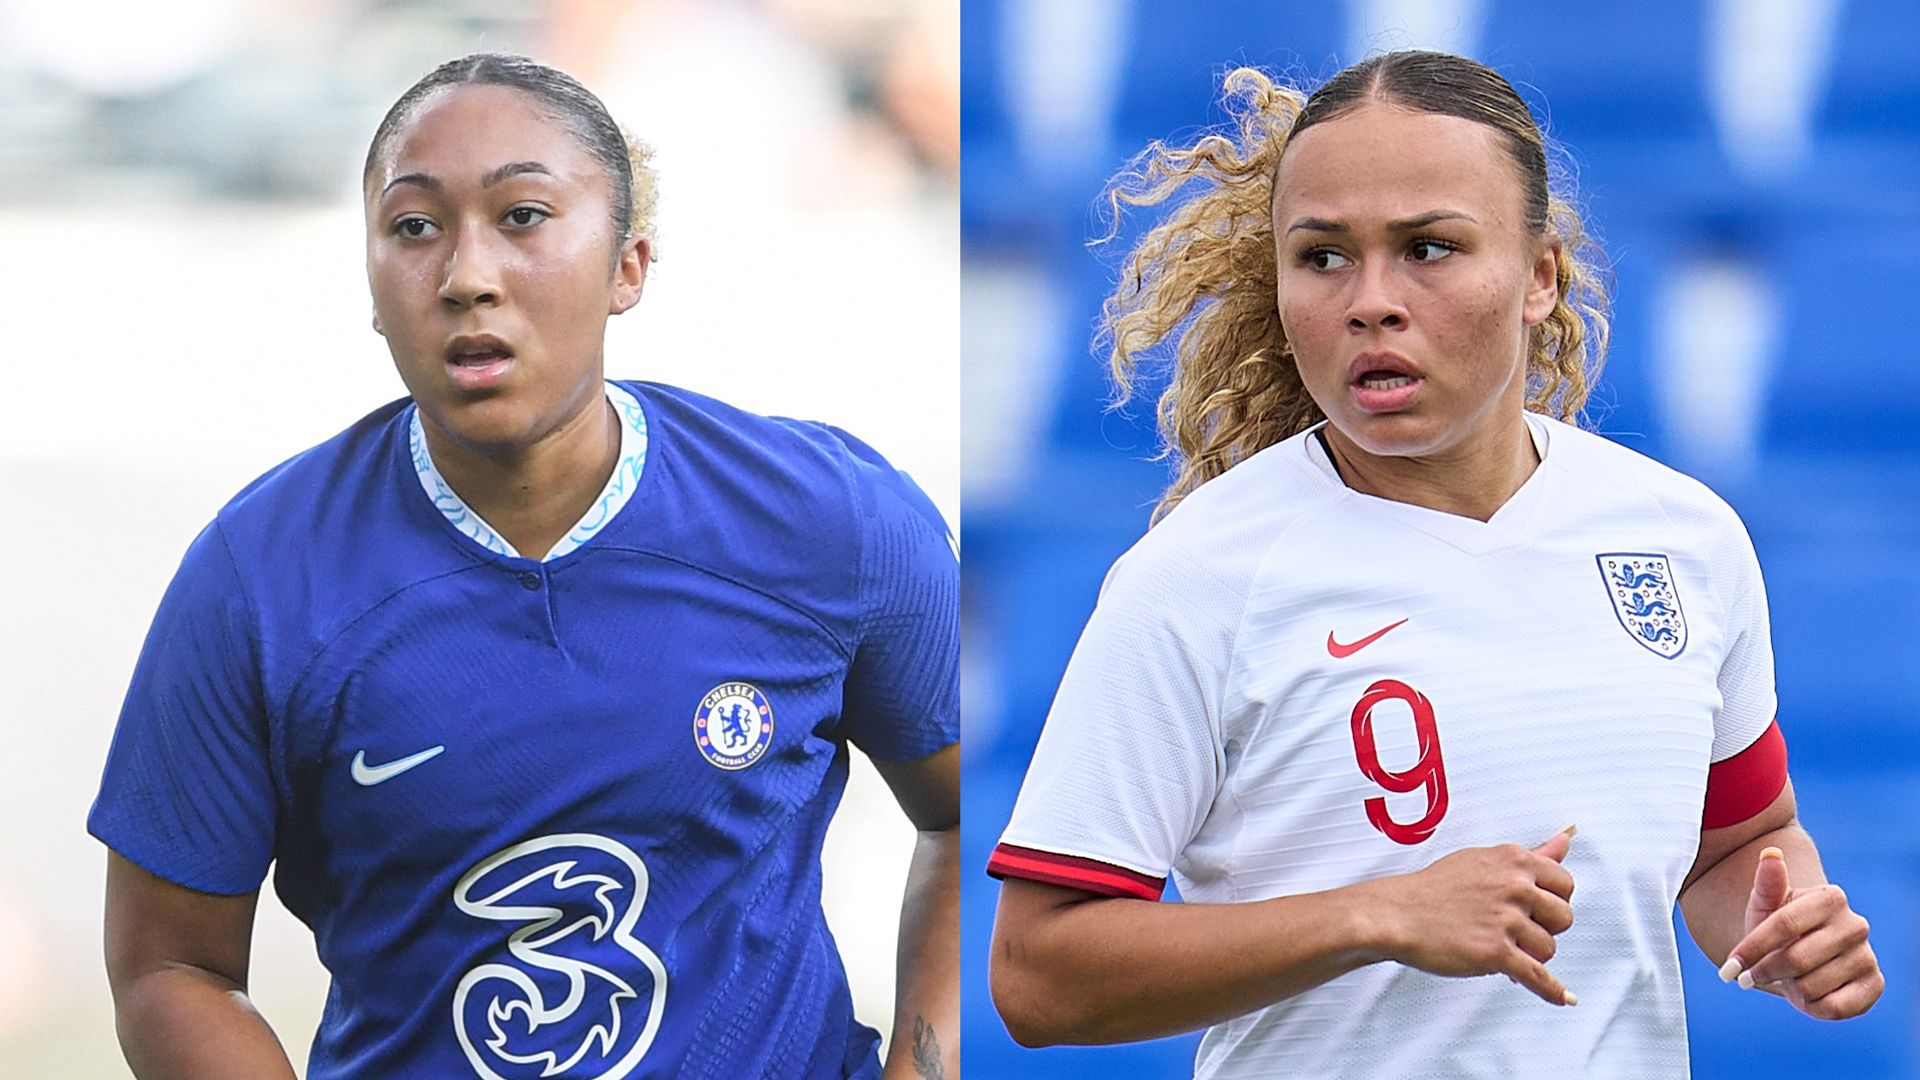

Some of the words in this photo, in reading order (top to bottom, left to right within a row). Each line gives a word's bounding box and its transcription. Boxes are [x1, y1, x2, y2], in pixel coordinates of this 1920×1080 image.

[704, 685, 755, 709] CHELSEA
[711, 752, 746, 765] FOOTBALL
[1350, 678, 1449, 845] 9
[452, 833, 667, 1080] 3
